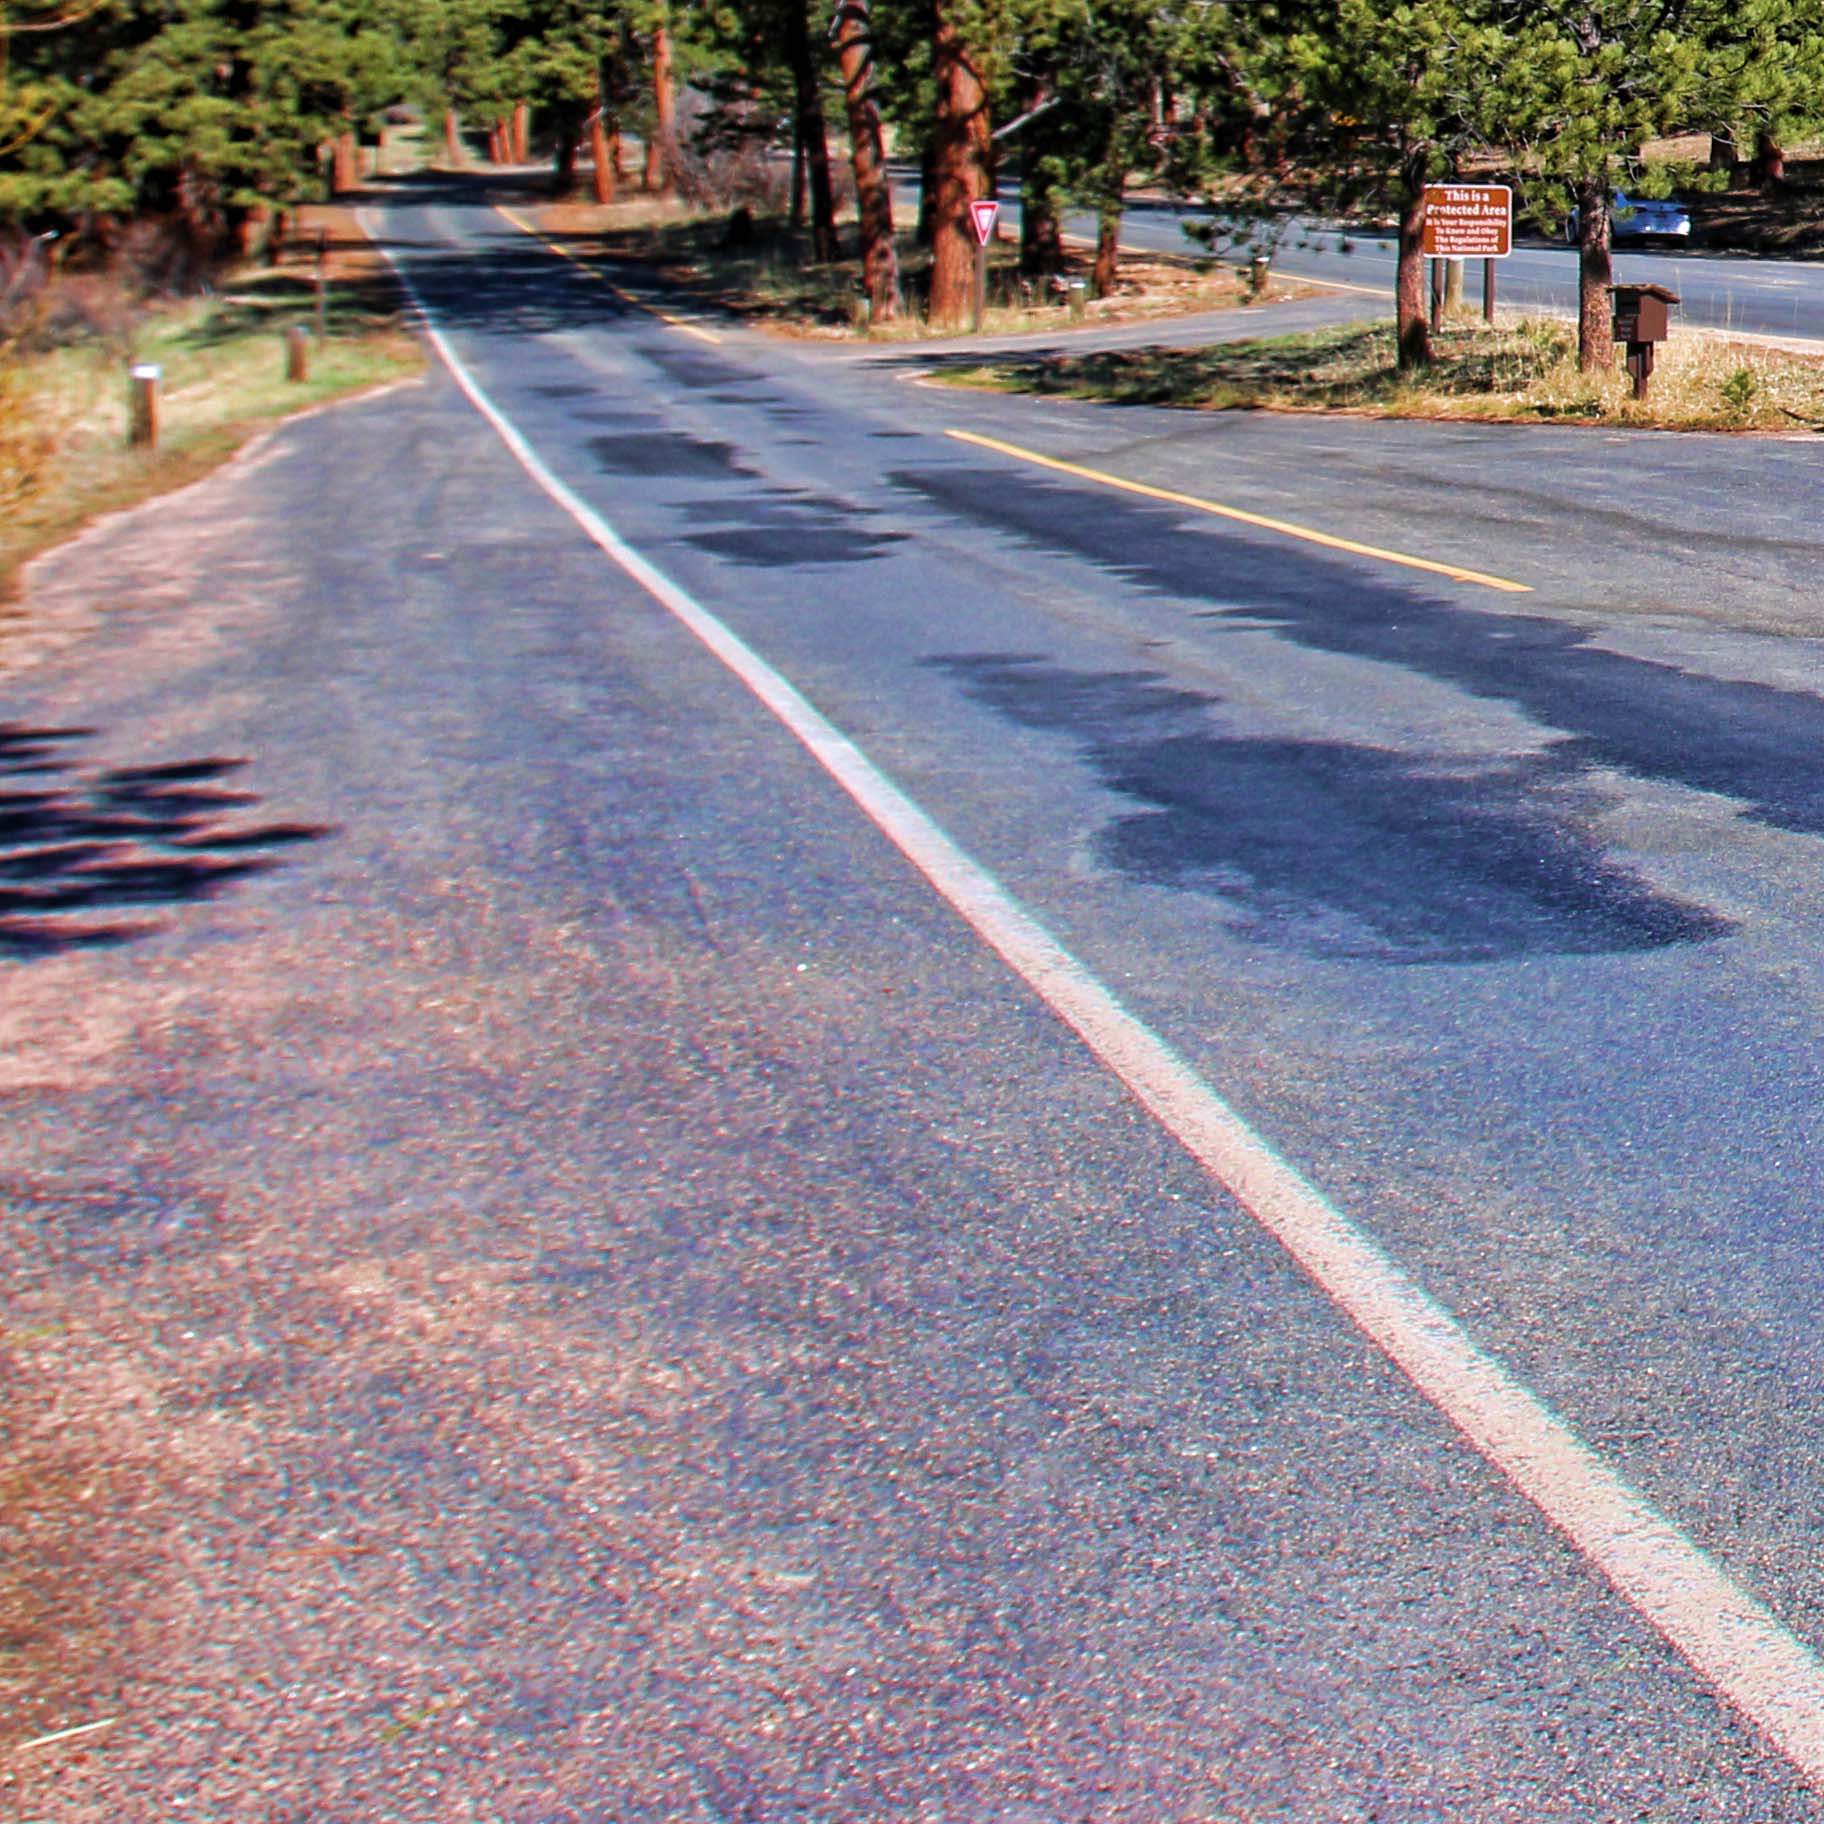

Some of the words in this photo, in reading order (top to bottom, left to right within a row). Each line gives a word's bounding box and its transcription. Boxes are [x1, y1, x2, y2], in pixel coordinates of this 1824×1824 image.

[1444, 190, 1470, 202] This
[1471, 190, 1481, 202] is
[1483, 193, 1489, 202] a
[1427, 204, 1480, 216] Protected
[1482, 205, 1507, 216] Area
[1435, 244, 1450, 252] This
